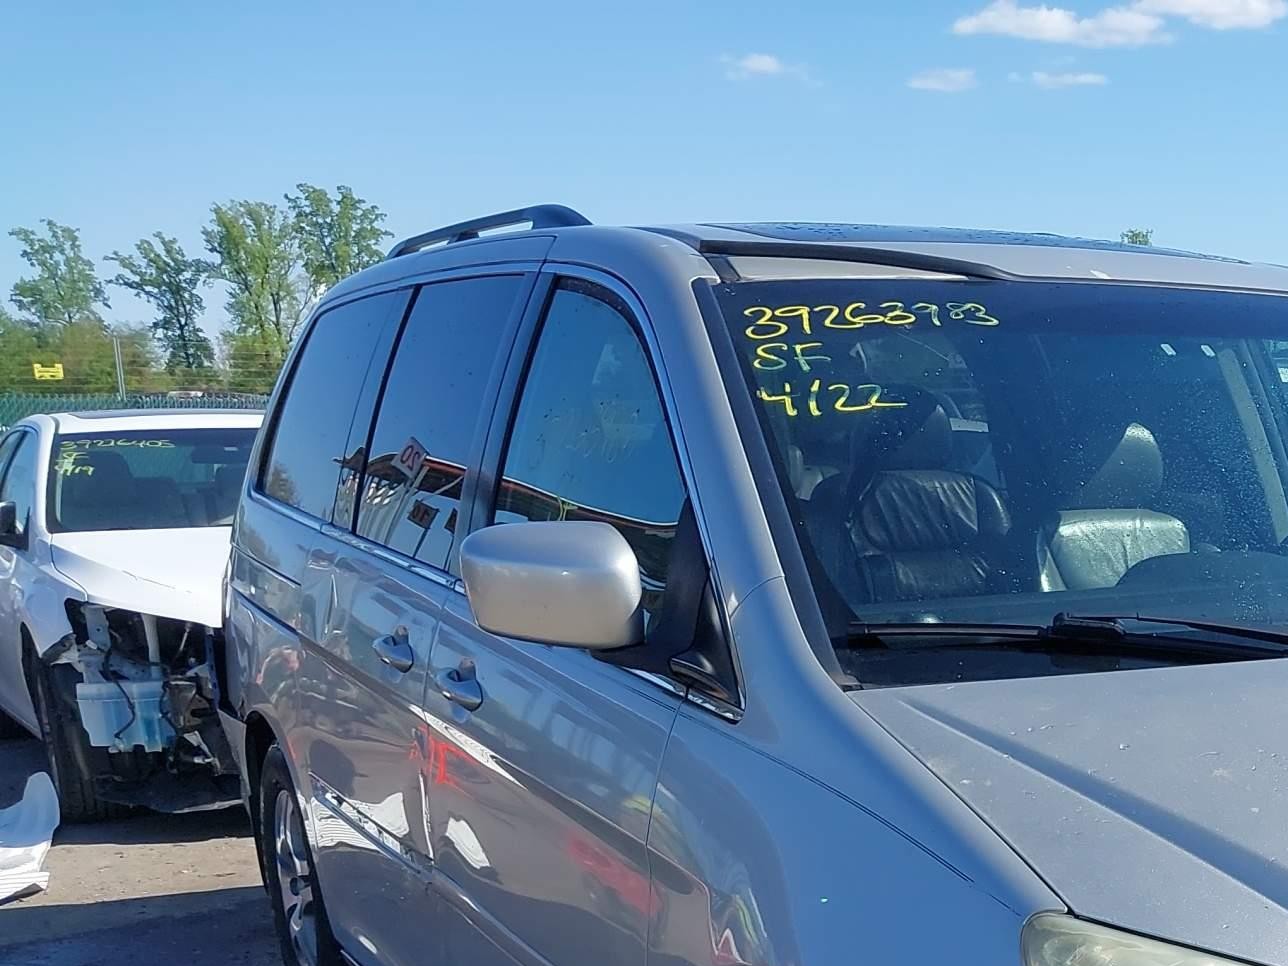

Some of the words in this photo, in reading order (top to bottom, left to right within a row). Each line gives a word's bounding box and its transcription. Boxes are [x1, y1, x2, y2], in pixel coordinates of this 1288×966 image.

[744, 302, 1000, 340] 39263983
[753, 343, 832, 372] SF
[756, 379, 908, 416] 4/22
